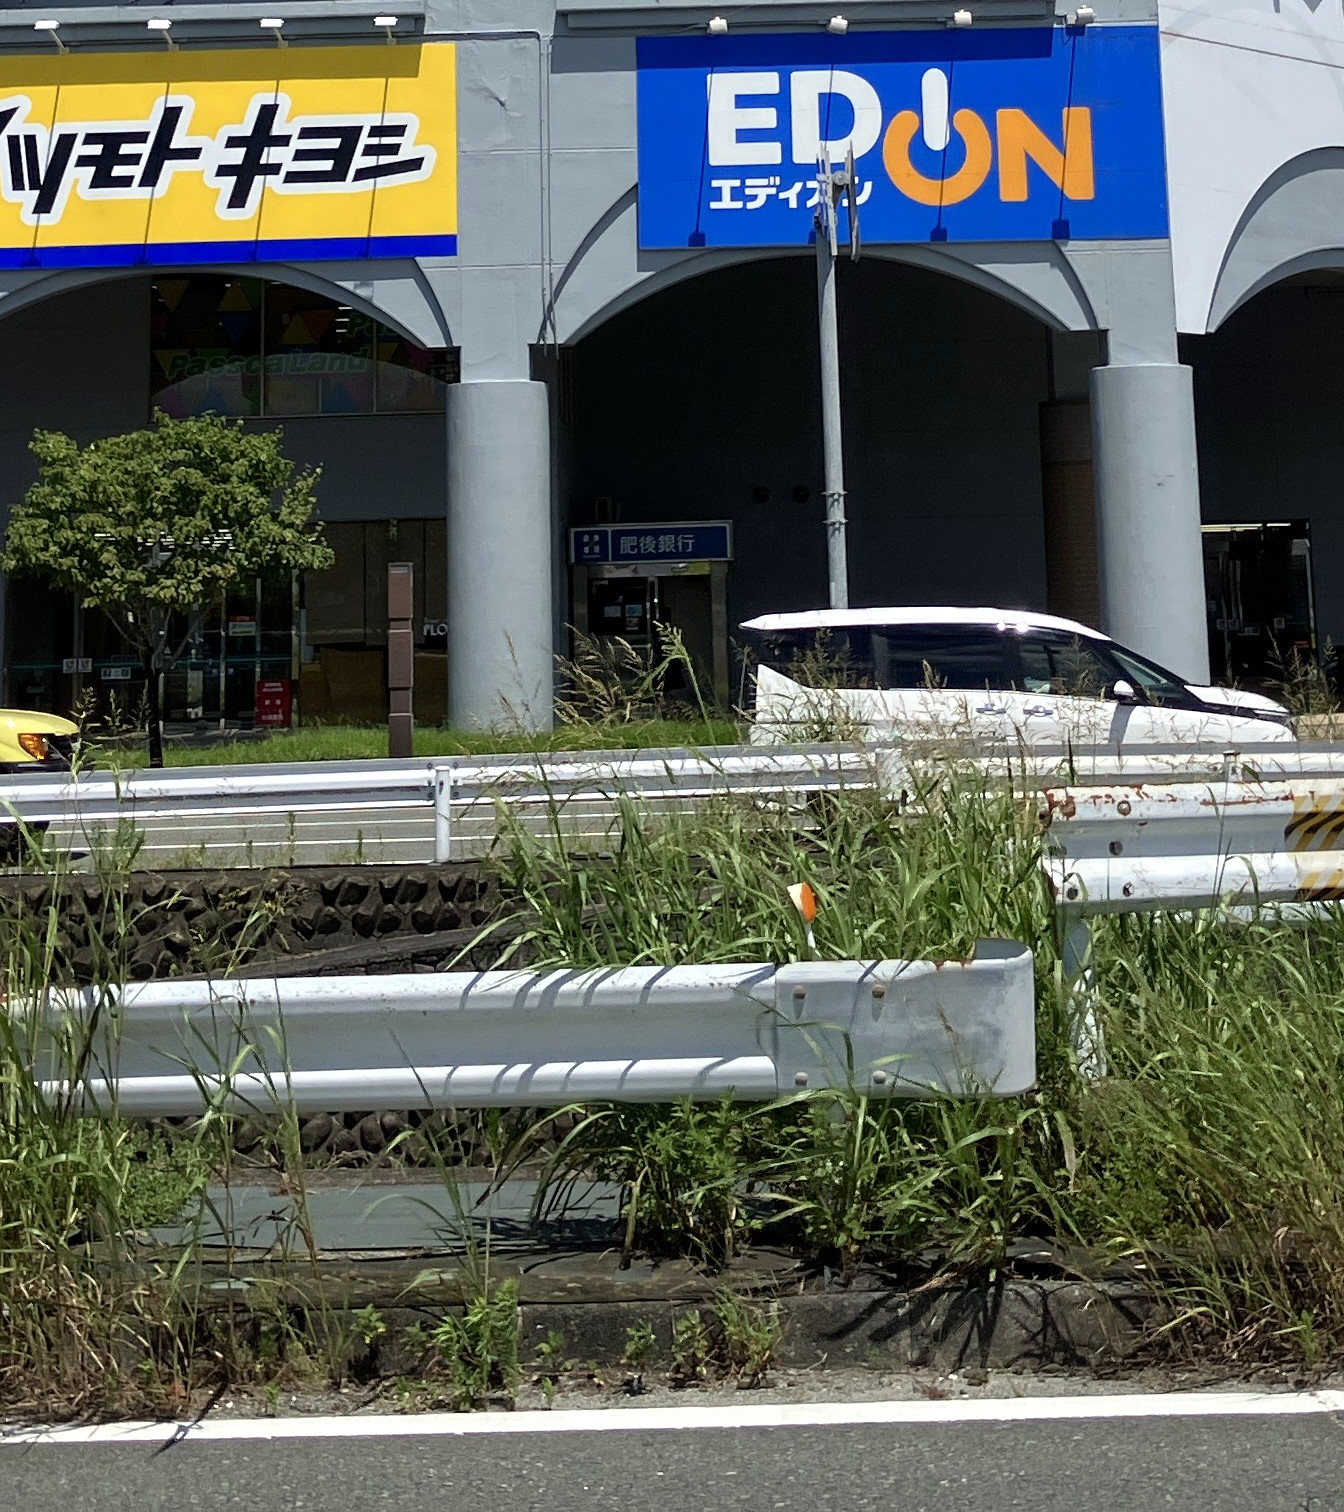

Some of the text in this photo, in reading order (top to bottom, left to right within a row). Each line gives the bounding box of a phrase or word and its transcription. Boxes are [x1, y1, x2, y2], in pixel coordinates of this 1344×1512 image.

[707, 68, 1095, 207] EDION
[620, 534, 696, 555] 肥後銀行
